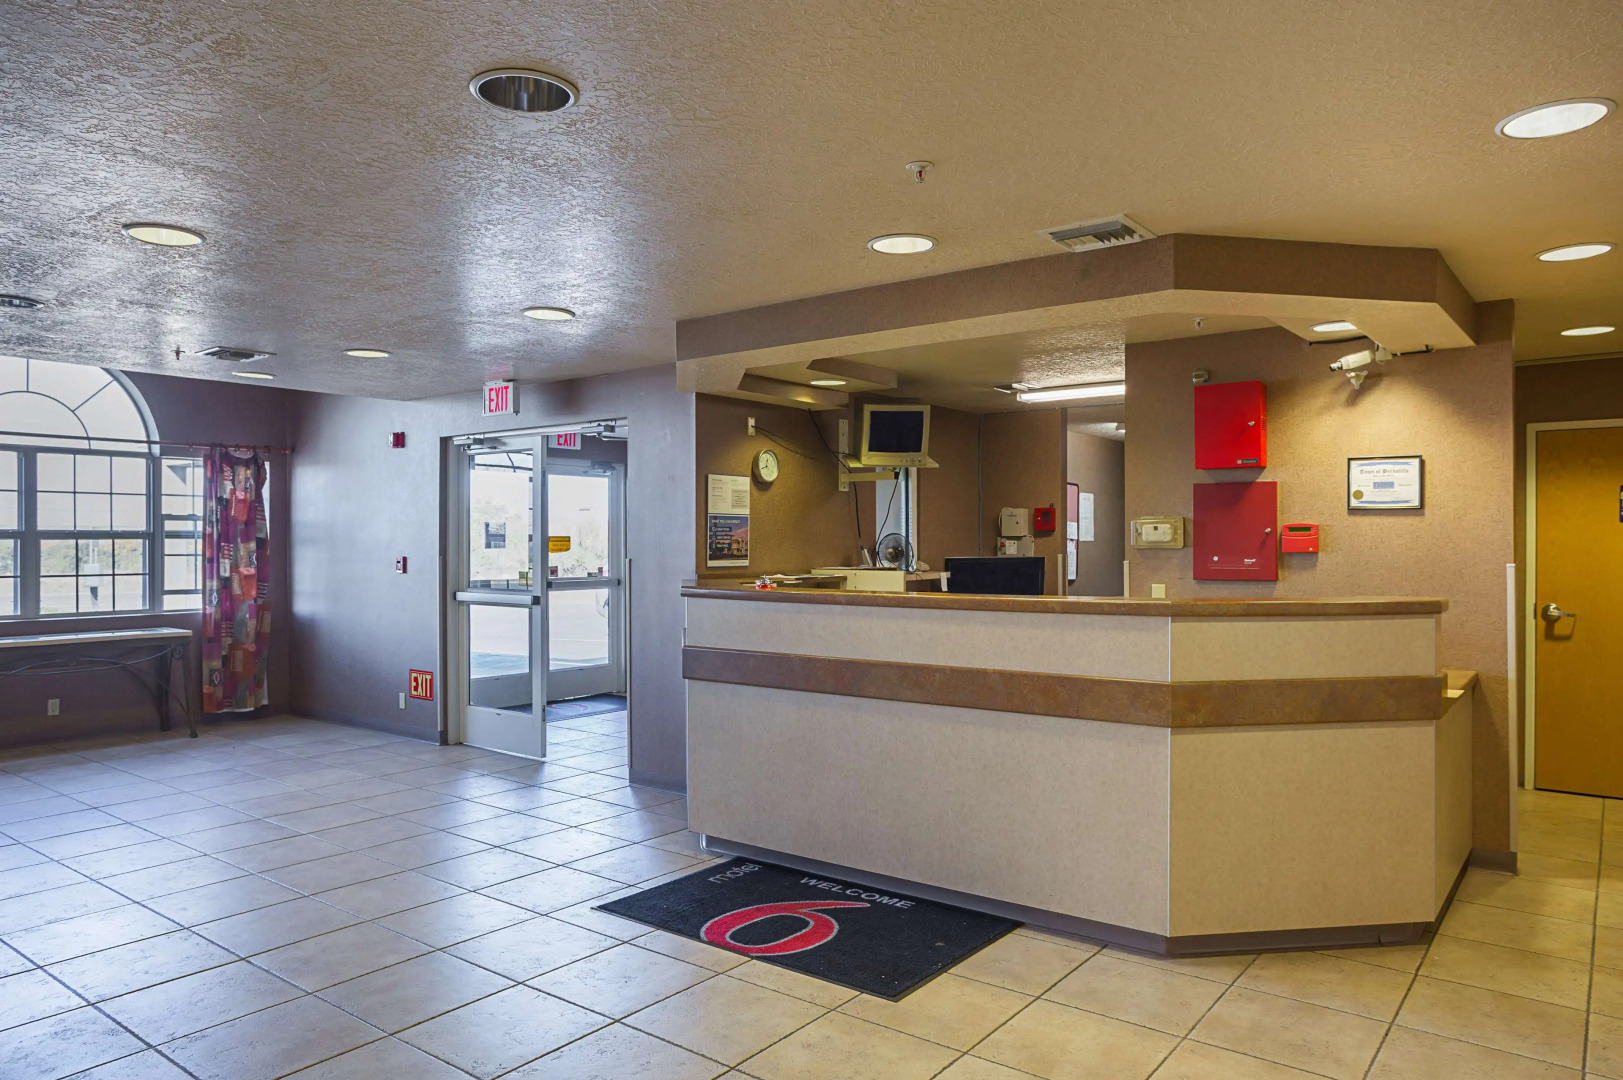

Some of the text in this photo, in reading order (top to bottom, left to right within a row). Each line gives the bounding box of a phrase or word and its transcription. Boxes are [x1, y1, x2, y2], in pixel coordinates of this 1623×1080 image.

[488, 385, 510, 414] EXIT
[411, 672, 432, 698] EXIT
[707, 862, 763, 884] motel
[800, 876, 916, 910] WELCOME
[700, 900, 871, 957] 6
